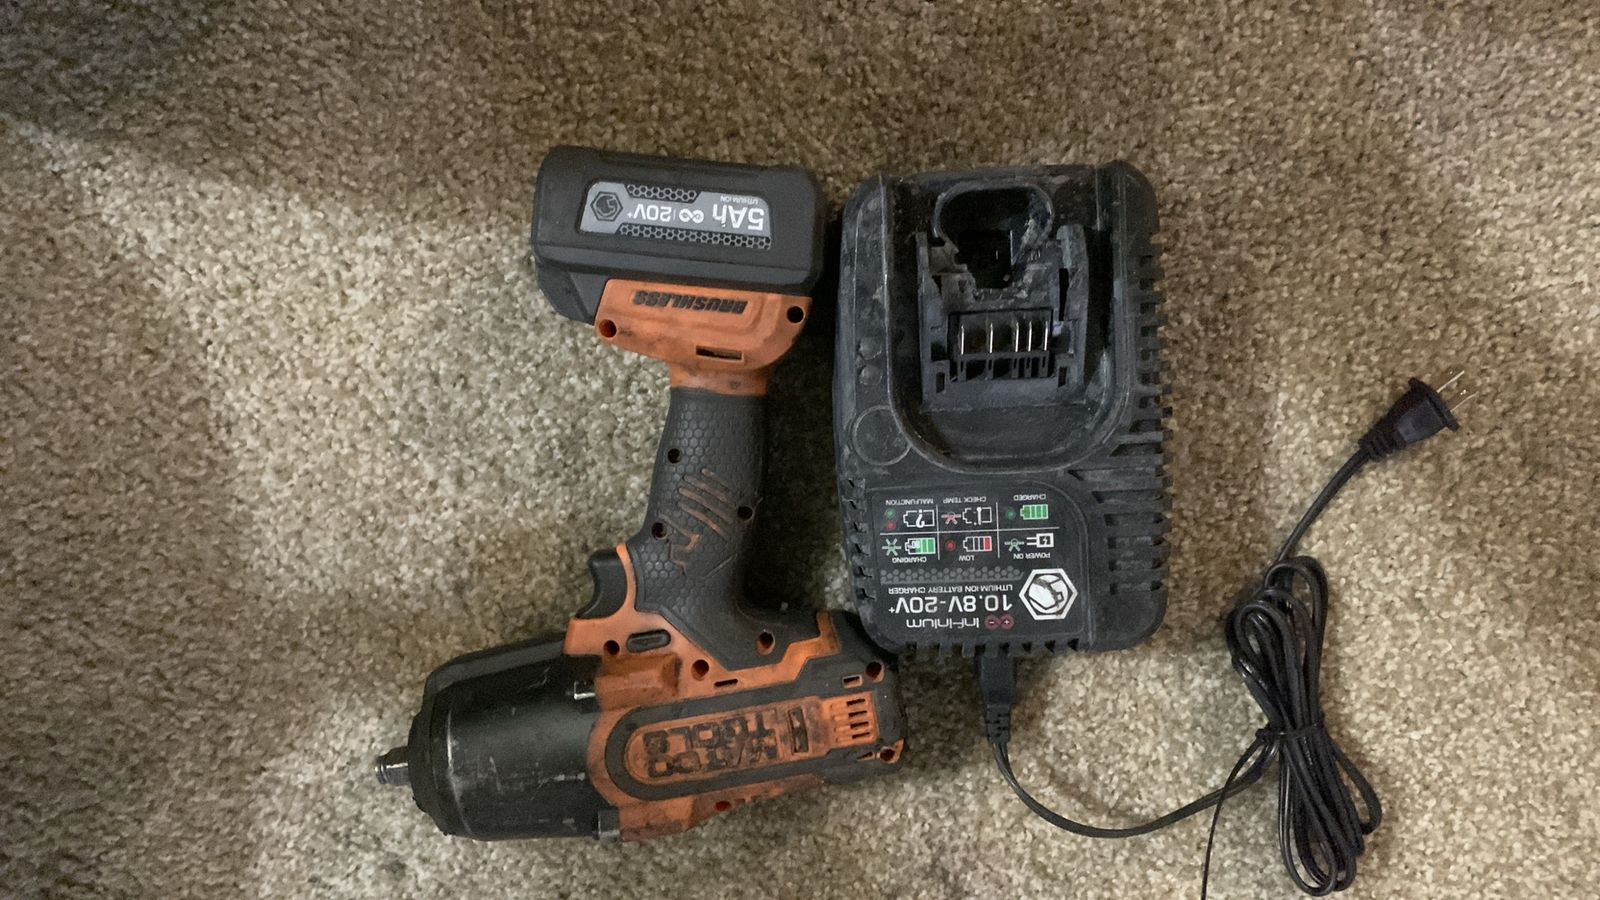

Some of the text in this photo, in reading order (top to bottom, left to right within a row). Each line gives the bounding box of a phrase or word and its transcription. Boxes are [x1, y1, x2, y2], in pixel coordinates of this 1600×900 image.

[712, 204, 765, 231] 5Ah
[633, 290, 748, 314] BRUSHLESS
[888, 586, 926, 595] CHARGER
[927, 585, 964, 593] BATTERY
